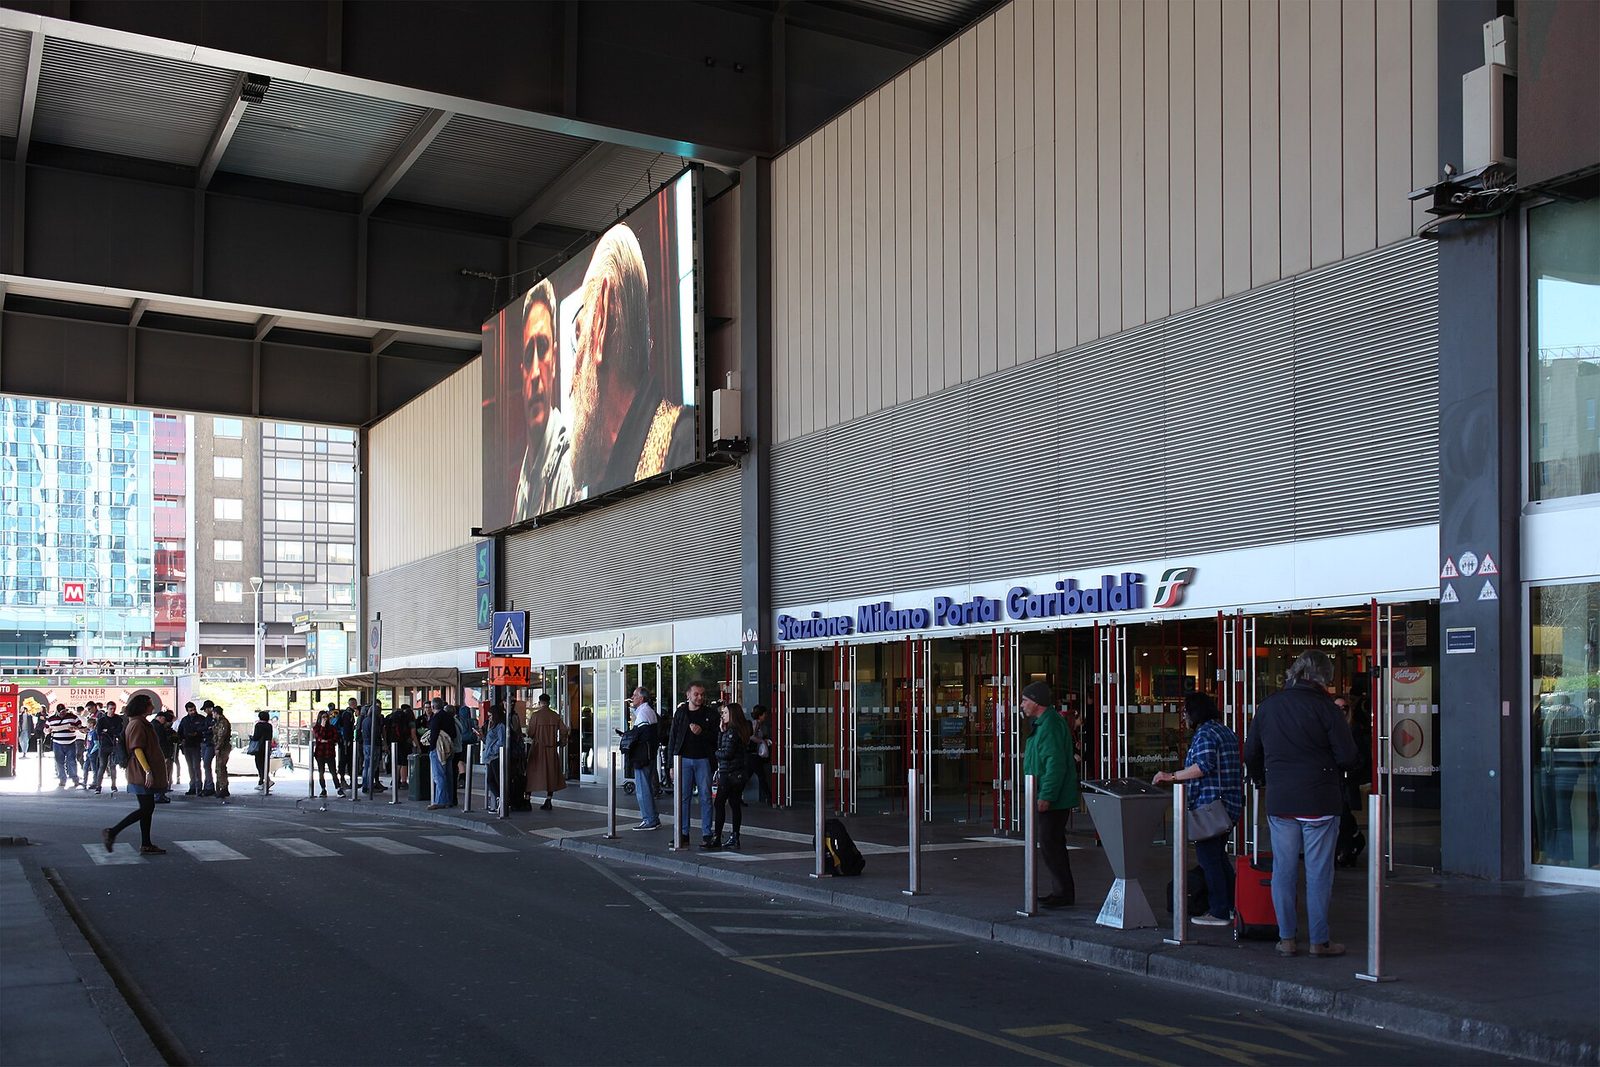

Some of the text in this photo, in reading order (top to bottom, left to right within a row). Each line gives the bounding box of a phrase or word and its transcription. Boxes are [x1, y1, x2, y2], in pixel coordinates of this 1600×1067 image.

[65, 585, 84, 600] M
[777, 572, 1146, 641] Stazione Milano Porta Garibaldi
[1320, 637, 1358, 648] express
[495, 665, 526, 677] TAXI
[1400, 766, 1417, 774] Porta
